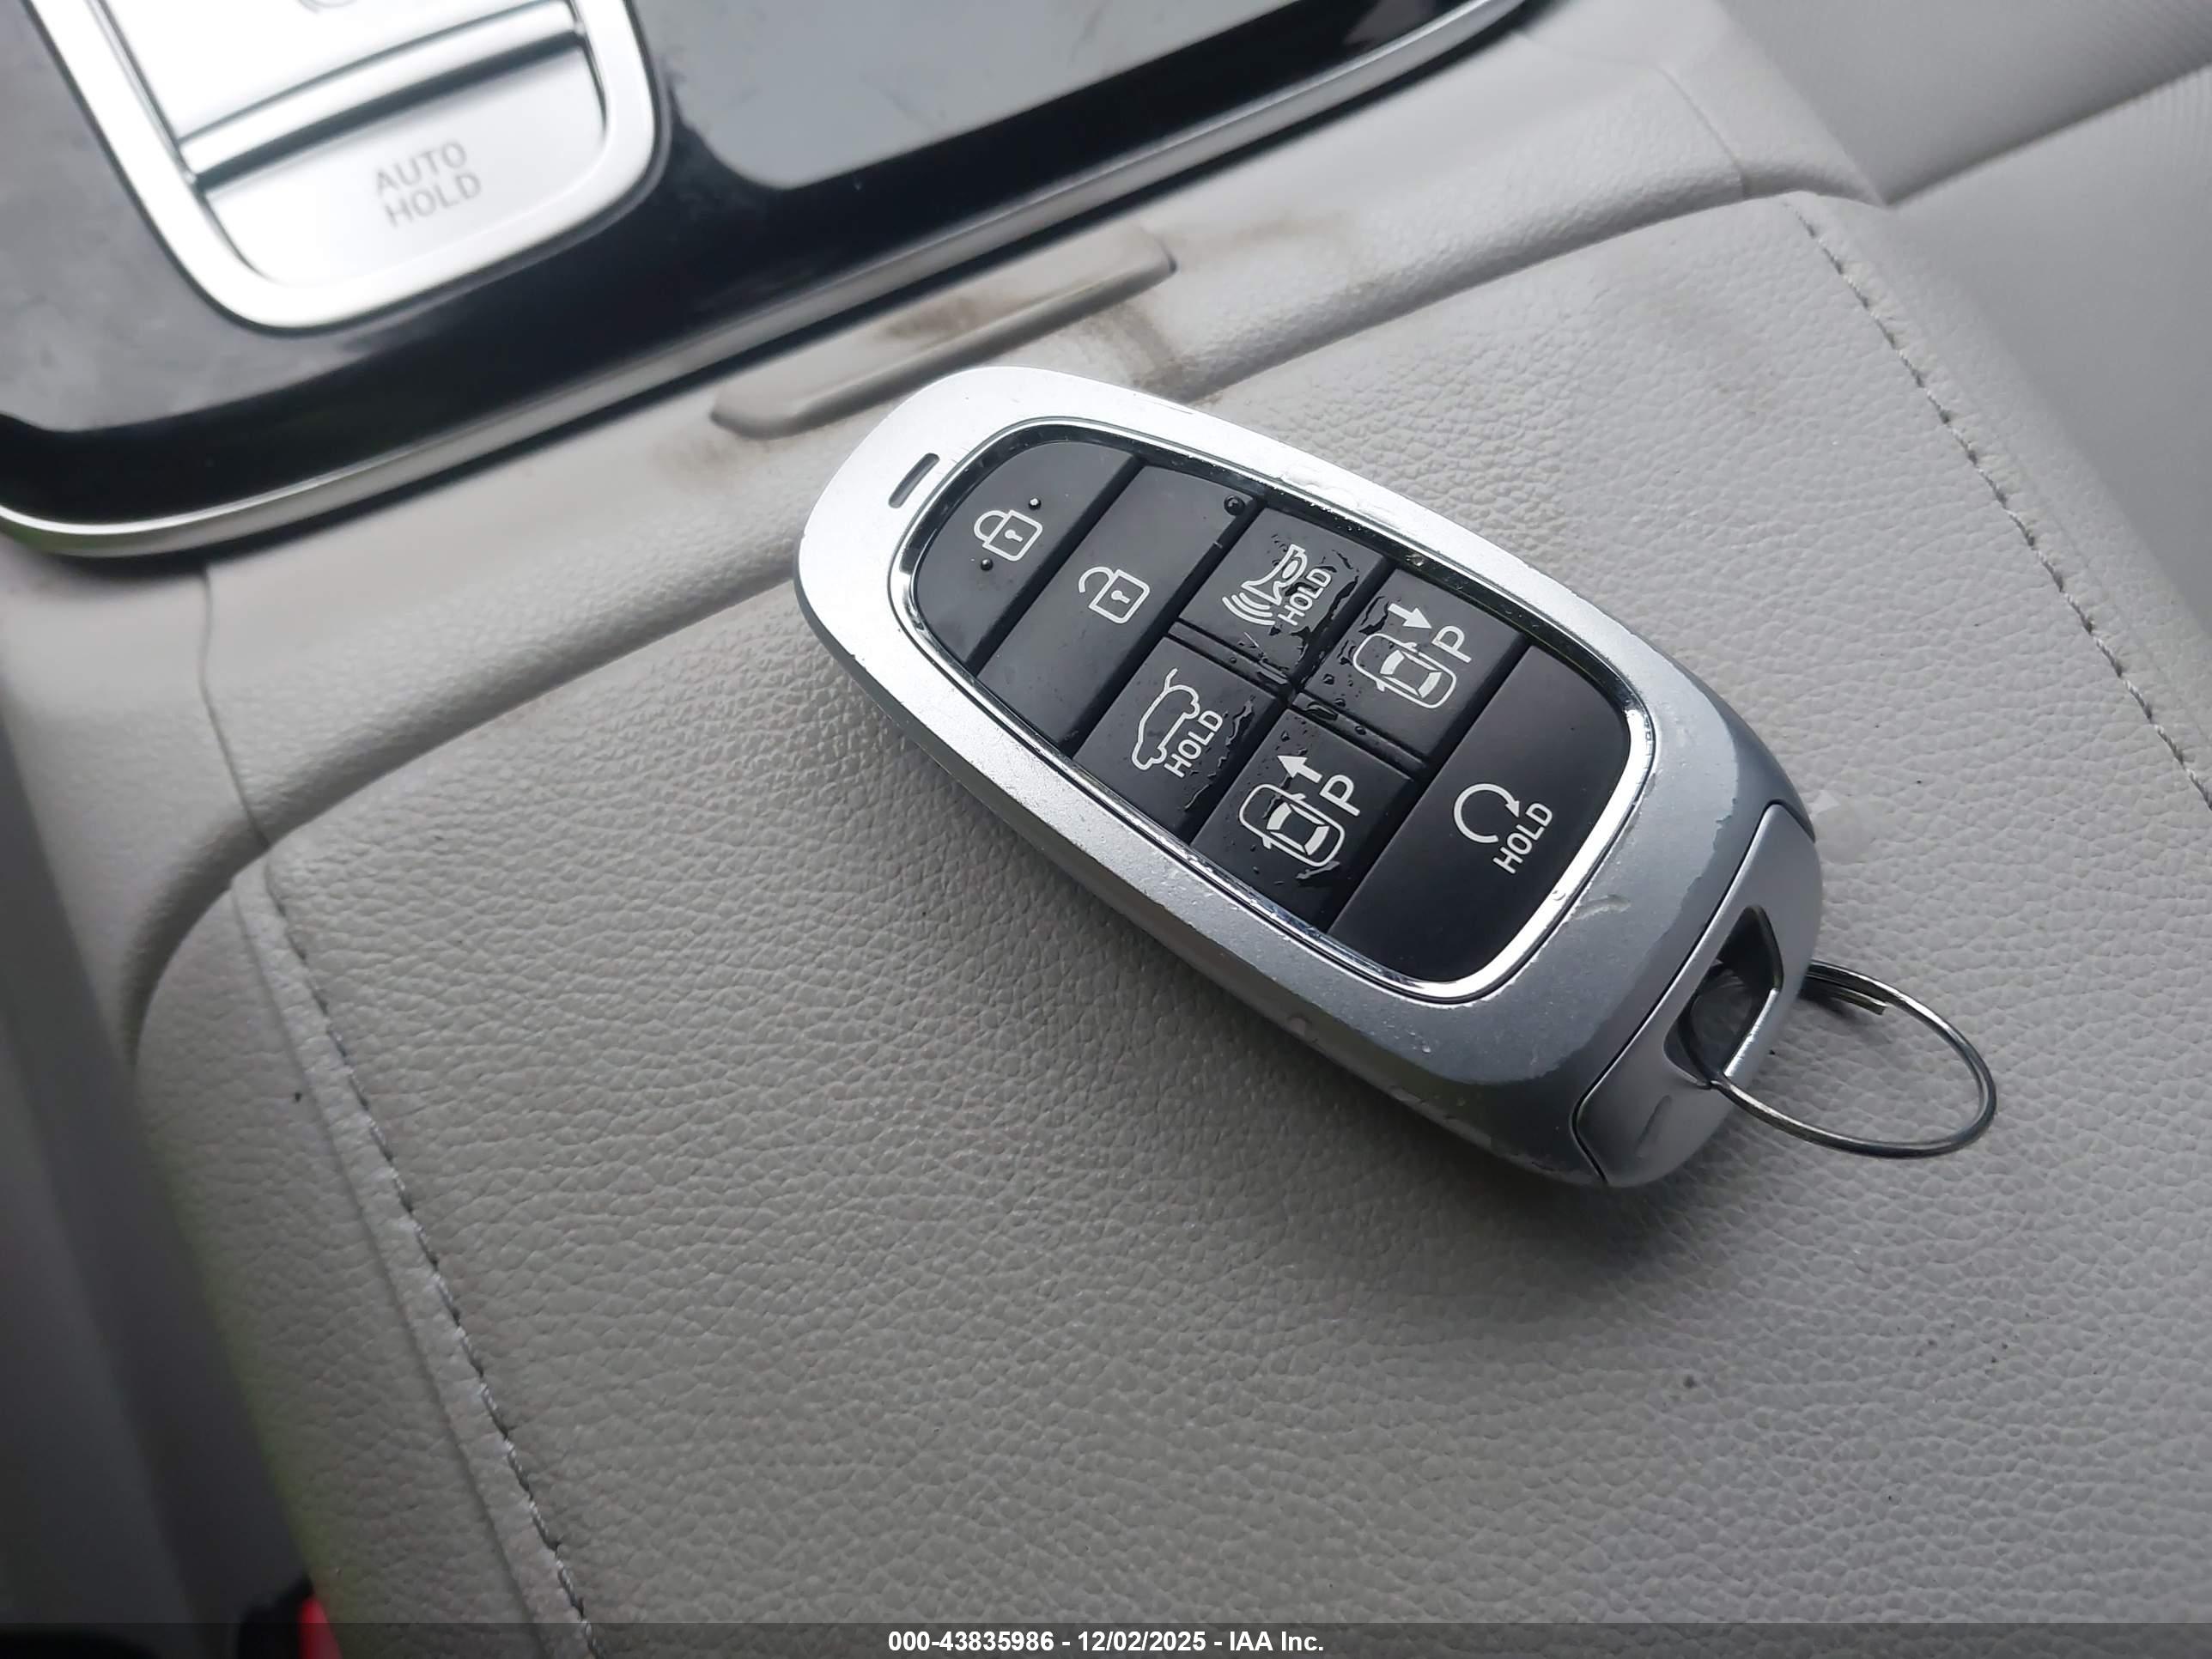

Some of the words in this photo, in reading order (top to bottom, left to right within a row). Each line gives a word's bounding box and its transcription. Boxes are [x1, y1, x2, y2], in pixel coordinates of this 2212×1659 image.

[376, 142, 466, 197] AUTO
[383, 173, 482, 228] HOLD
[1277, 568, 1332, 626] HOLD
[1431, 625, 1472, 663] P
[1164, 710, 1223, 778] HOLD
[1319, 775, 1360, 817] P
[1492, 803, 1553, 874] HOLD
